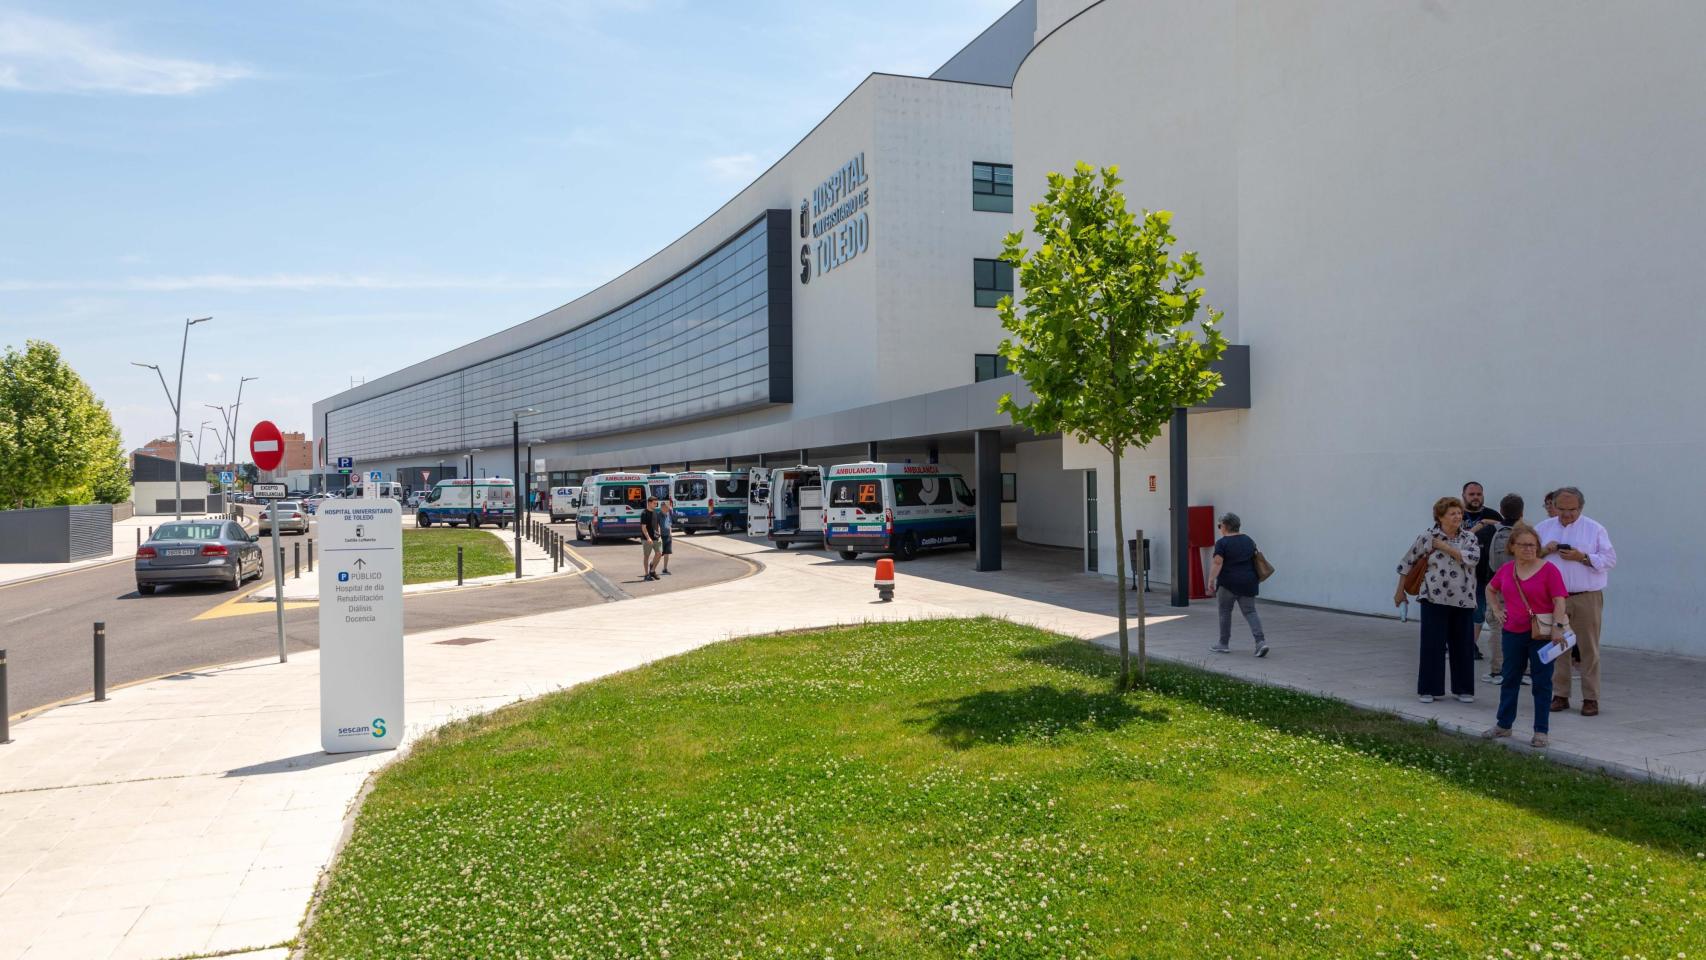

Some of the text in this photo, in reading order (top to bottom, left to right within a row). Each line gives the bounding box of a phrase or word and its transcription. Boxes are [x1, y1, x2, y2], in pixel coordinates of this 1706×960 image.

[813, 152, 869, 219] HOSPITAL
[858, 187, 870, 210] DE
[814, 212, 869, 277] TOLEDO
[836, 467, 877, 475] AMBULANCIA
[903, 466, 939, 474] AMBULANCIA
[557, 488, 573, 496] GLS
[351, 571, 382, 580] PÚBLICO
[335, 585, 363, 593] Hospital
[336, 594, 384, 602] Rehabilitación
[348, 604, 373, 613] Diálisis
[345, 615, 376, 623] Docencia
[338, 726, 370, 734] sescam
